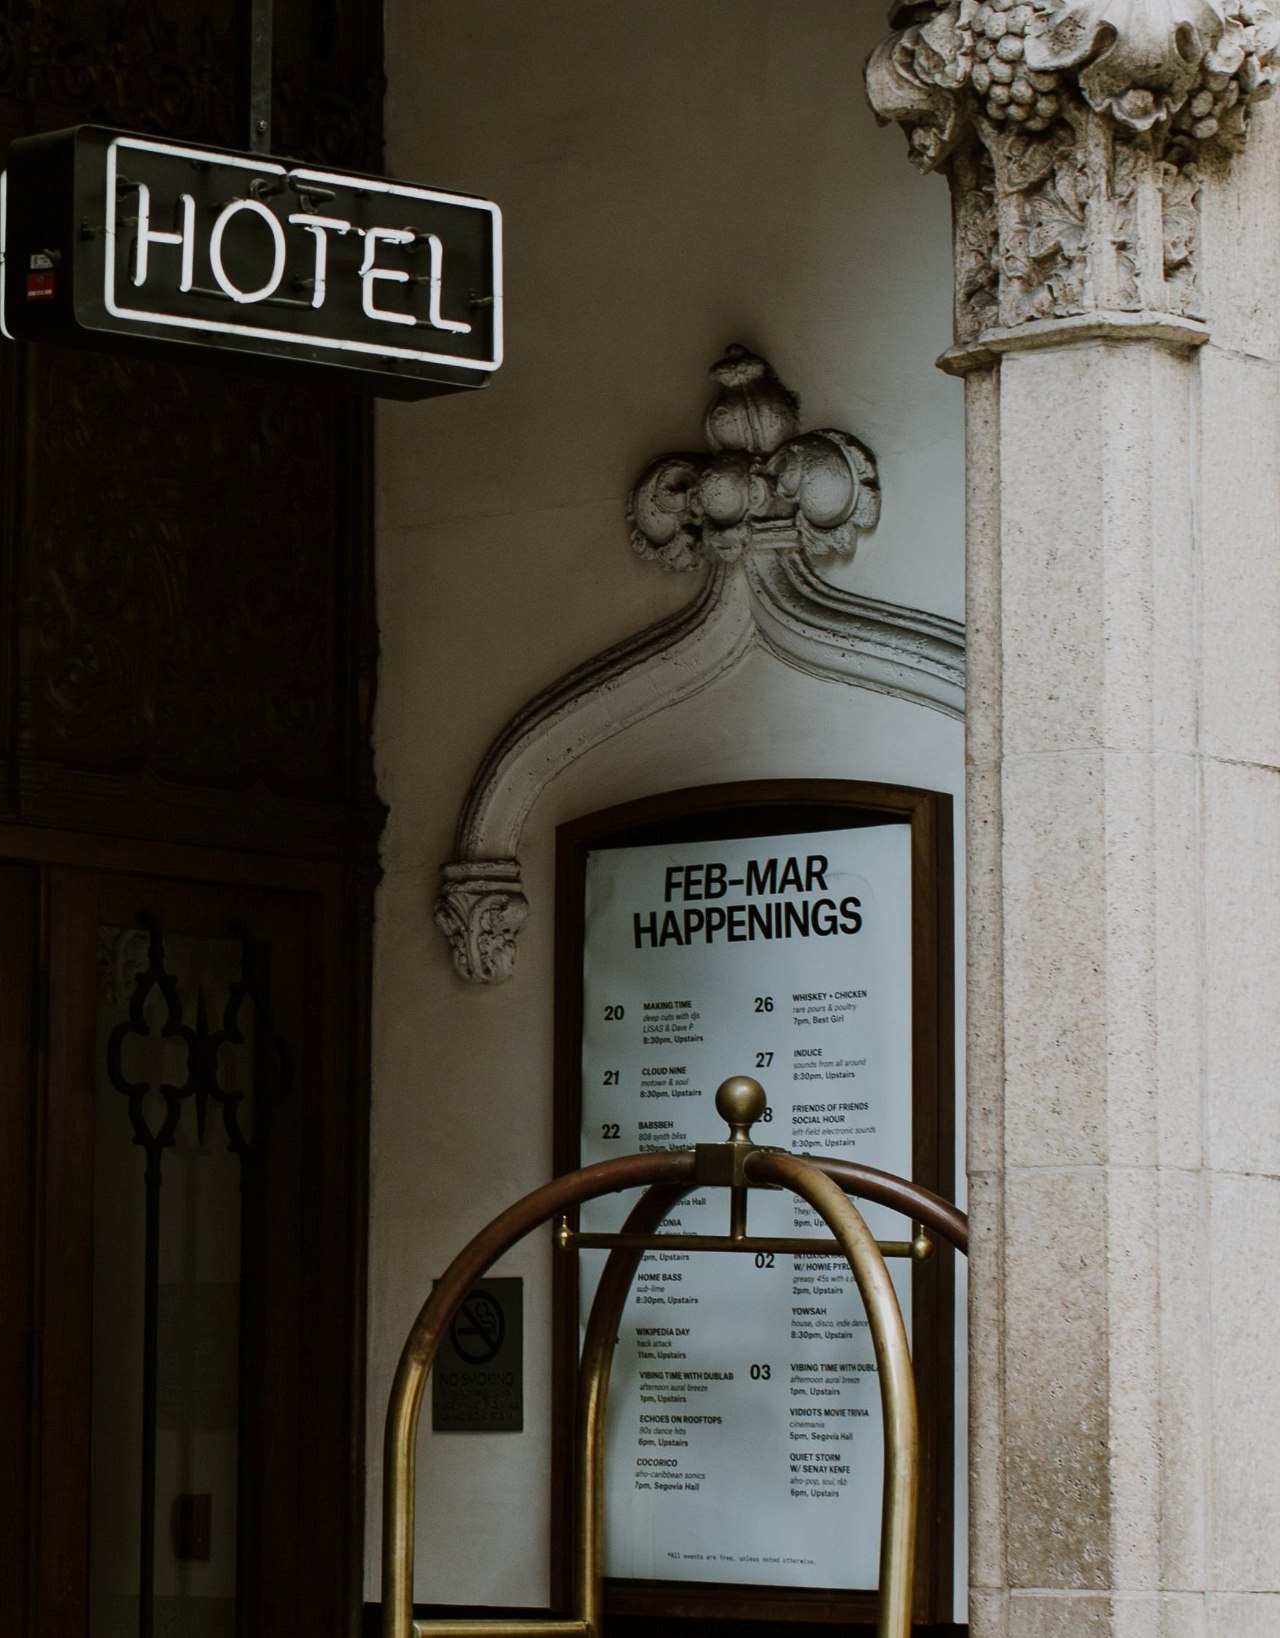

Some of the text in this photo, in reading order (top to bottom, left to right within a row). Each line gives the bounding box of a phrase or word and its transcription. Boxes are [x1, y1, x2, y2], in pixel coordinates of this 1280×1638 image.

[130, 183, 472, 333] HOTEL
[633, 897, 863, 949] HAPPENINGS
[792, 992, 827, 1001] WHISKEY
[834, 990, 868, 999] CHICKEN
[643, 1001, 692, 1010] MAKING TIME
[754, 997, 774, 1013] 26
[834, 1003, 857, 1012] poultry
[604, 1005, 625, 1021] 20
[676, 1012, 689, 1020] with
[813, 1016, 829, 1024] Best
[830, 1015, 845, 1023] Girl
[674, 1034, 703, 1044] Upstairs
[794, 1048, 823, 1057] INDUCE
[755, 1052, 774, 1068] 27
[642, 1066, 687, 1076] CLOUD NINE
[825, 1070, 855, 1079] Upstairs
[603, 1070, 619, 1085] 21
[668, 1078, 674, 1086] &
[671, 1089, 702, 1098] Upstairs
[792, 1102, 869, 1113] FRIENDS OF FRIENDS
[756, 1107, 773, 1123] 8
[792, 1115, 845, 1125] SOCIAL HOUR
[602, 1123, 621, 1139] 22
[825, 1139, 856, 1147] Upstairs
[692, 1197, 707, 1206] Hall
[659, 1253, 690, 1262] Upstairs
[755, 1252, 775, 1269] 02
[793, 1263, 804, 1271] W/
[806, 1263, 832, 1271] HOWIE
[637, 1273, 682, 1281] HOME BASS
[813, 1286, 844, 1295] Upstairs
[667, 1296, 699, 1304] Upstairs
[792, 1307, 827, 1316] YOWSAH
[635, 1328, 691, 1336] WIKIPEDIA DAY
[825, 1331, 853, 1339] Upstairs
[657, 1351, 687, 1360] Upstairs
[750, 1364, 771, 1380] 03
[790, 1363, 856, 1372] VIBING TIME WITH
[639, 1371, 734, 1380] VIBING TIME WITH DUBLAB
[790, 1375, 823, 1384] afternoon
[842, 1376, 860, 1384] breeze
[639, 1383, 669, 1391] afternoon
[687, 1384, 708, 1392] breeze
[809, 1387, 840, 1396] Upstairs
[657, 1394, 687, 1403] Upstairs
[790, 1408, 869, 1417] VIDIOTS MOVIE TRIVIA
[639, 1415, 722, 1424] ECHOES ON ROOFTOPS
[653, 1427, 672, 1435] dance
[811, 1432, 839, 1442] Segovia
[658, 1438, 688, 1447] Upstairs
[790, 1452, 841, 1461] QUIET STORM
[636, 1458, 678, 1467] COCORICO
[802, 1465, 828, 1473] SENAY
[654, 1482, 683, 1491] Segovia
[810, 1489, 839, 1497] Upstairs
